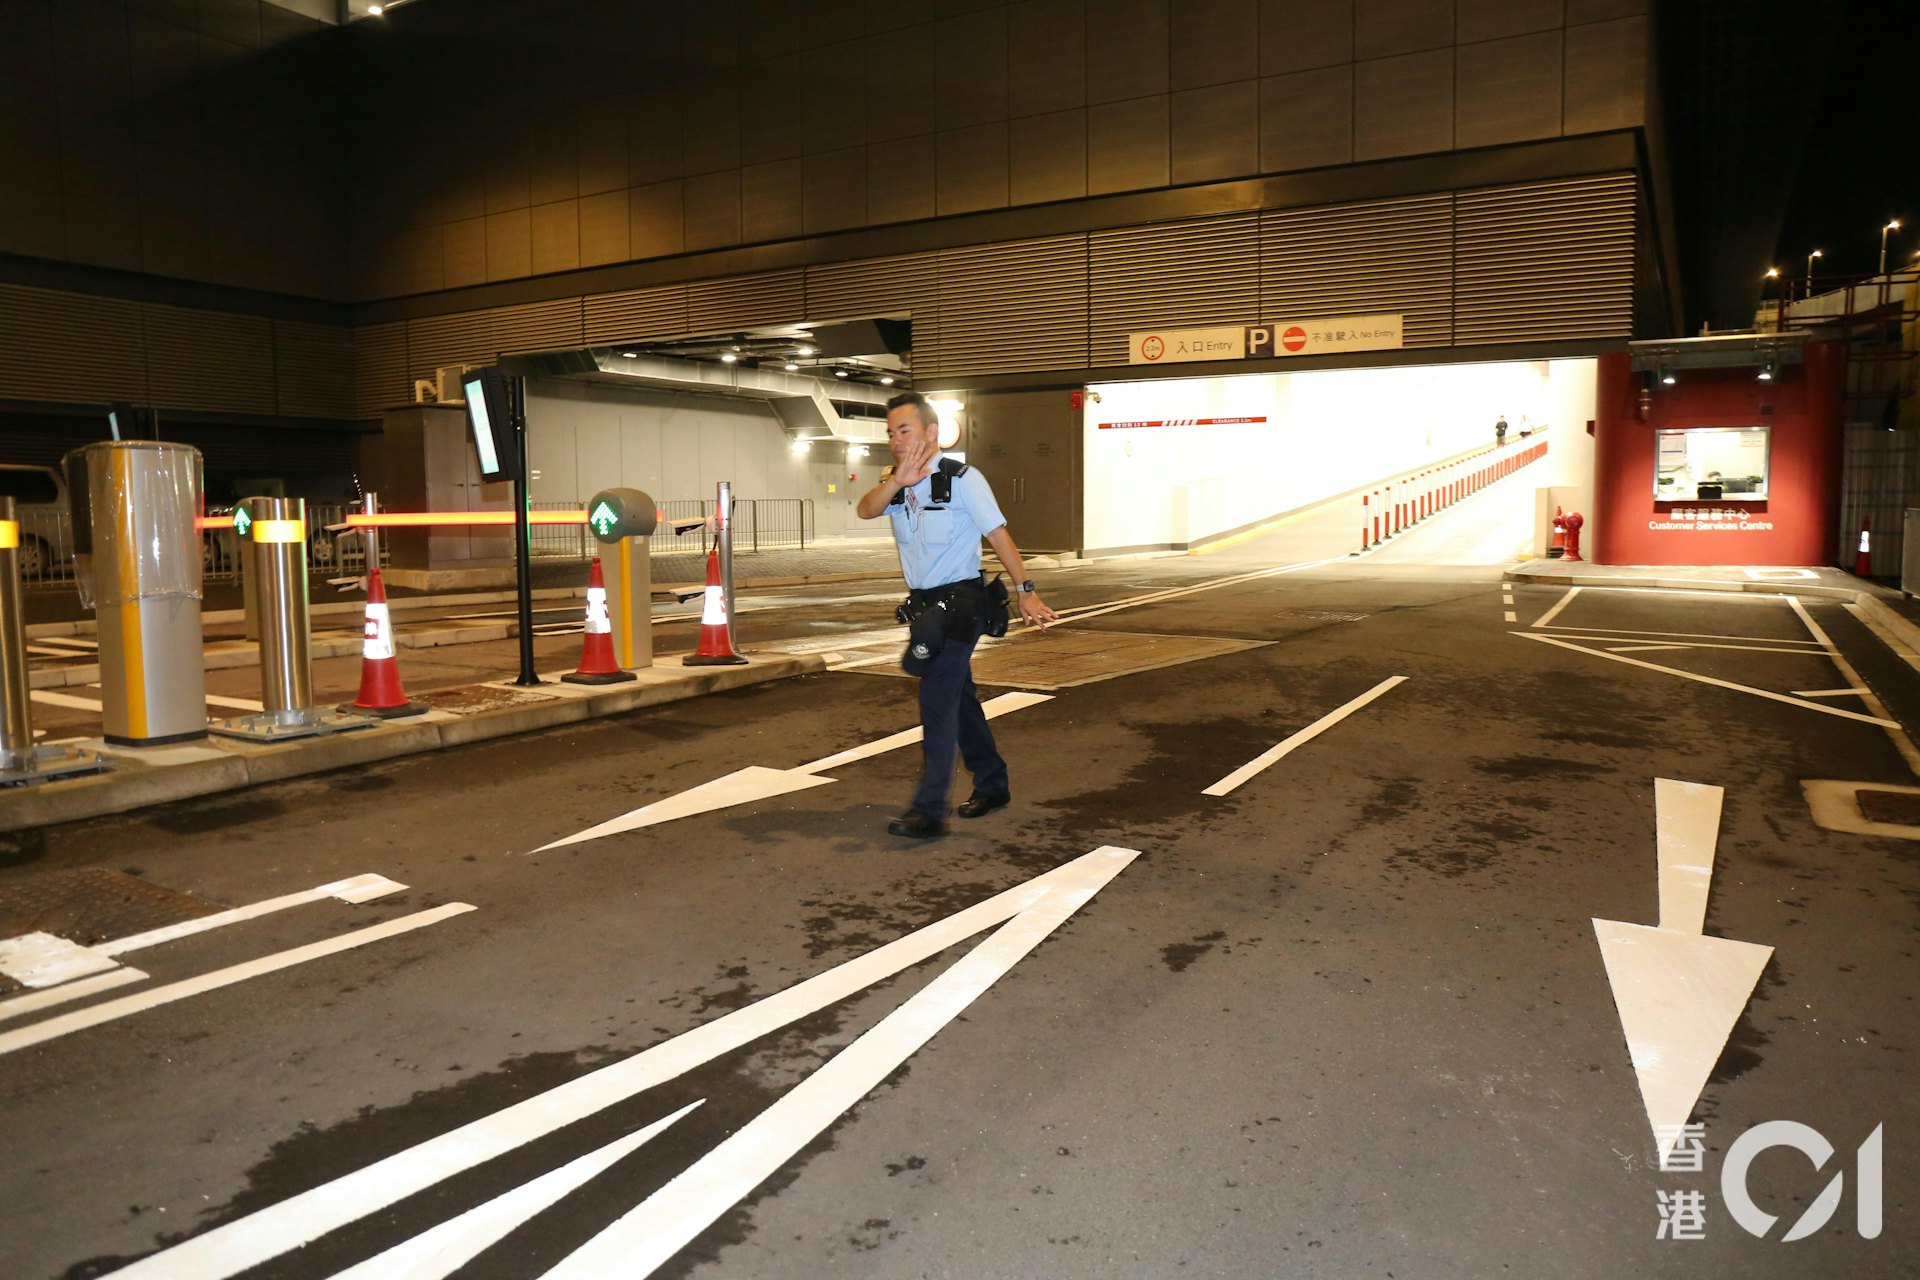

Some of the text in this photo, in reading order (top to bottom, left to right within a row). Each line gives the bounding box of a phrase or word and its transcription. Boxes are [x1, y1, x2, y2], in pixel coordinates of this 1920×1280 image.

[1249, 328, 1269, 354] P
[1311, 329, 1395, 343] 不准駛入 No Entry
[1176, 341, 1233, 354] 入口 Entry
[1648, 521, 1773, 531] Customer Services Centre
